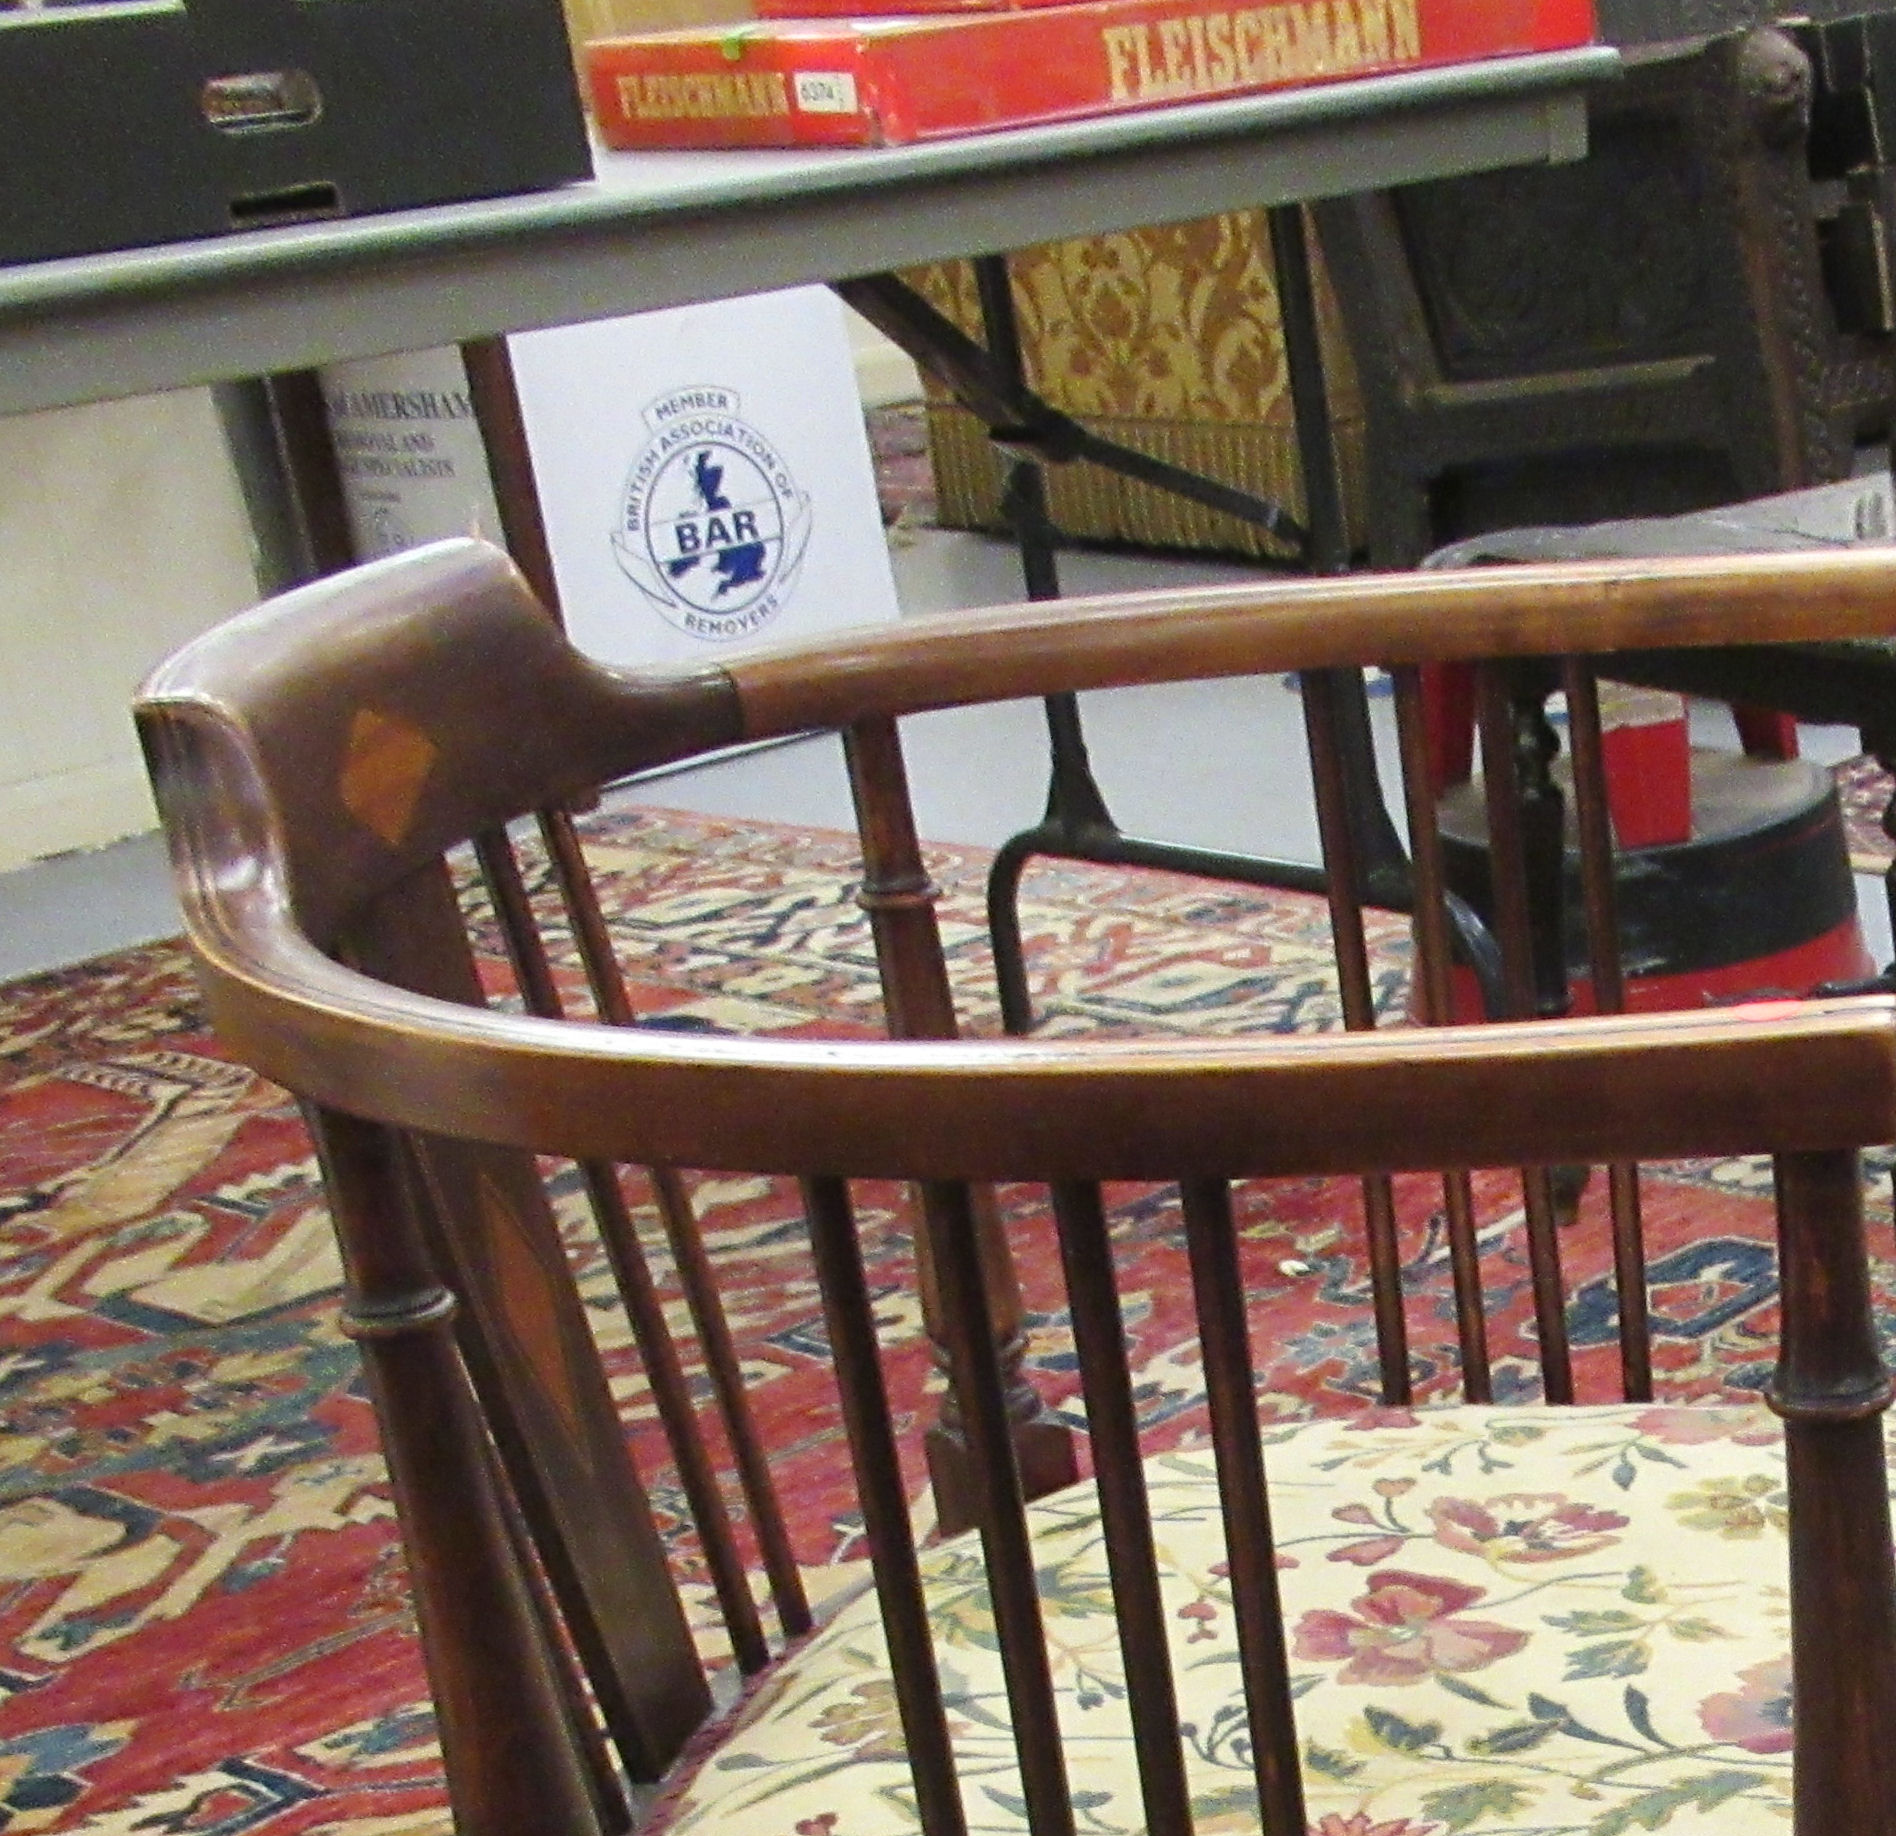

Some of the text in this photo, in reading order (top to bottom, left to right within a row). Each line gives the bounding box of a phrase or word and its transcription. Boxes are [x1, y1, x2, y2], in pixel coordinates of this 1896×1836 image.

[1102, 0, 1421, 104] FLEISCHMANN
[616, 71, 790, 119] FLEISCHMANN
[655, 394, 728, 421] MEMBER
[626, 419, 793, 532] BRITISH ASSOCIATION OF
[675, 510, 760, 554] BAR
[684, 596, 779, 634] REMOVERS
